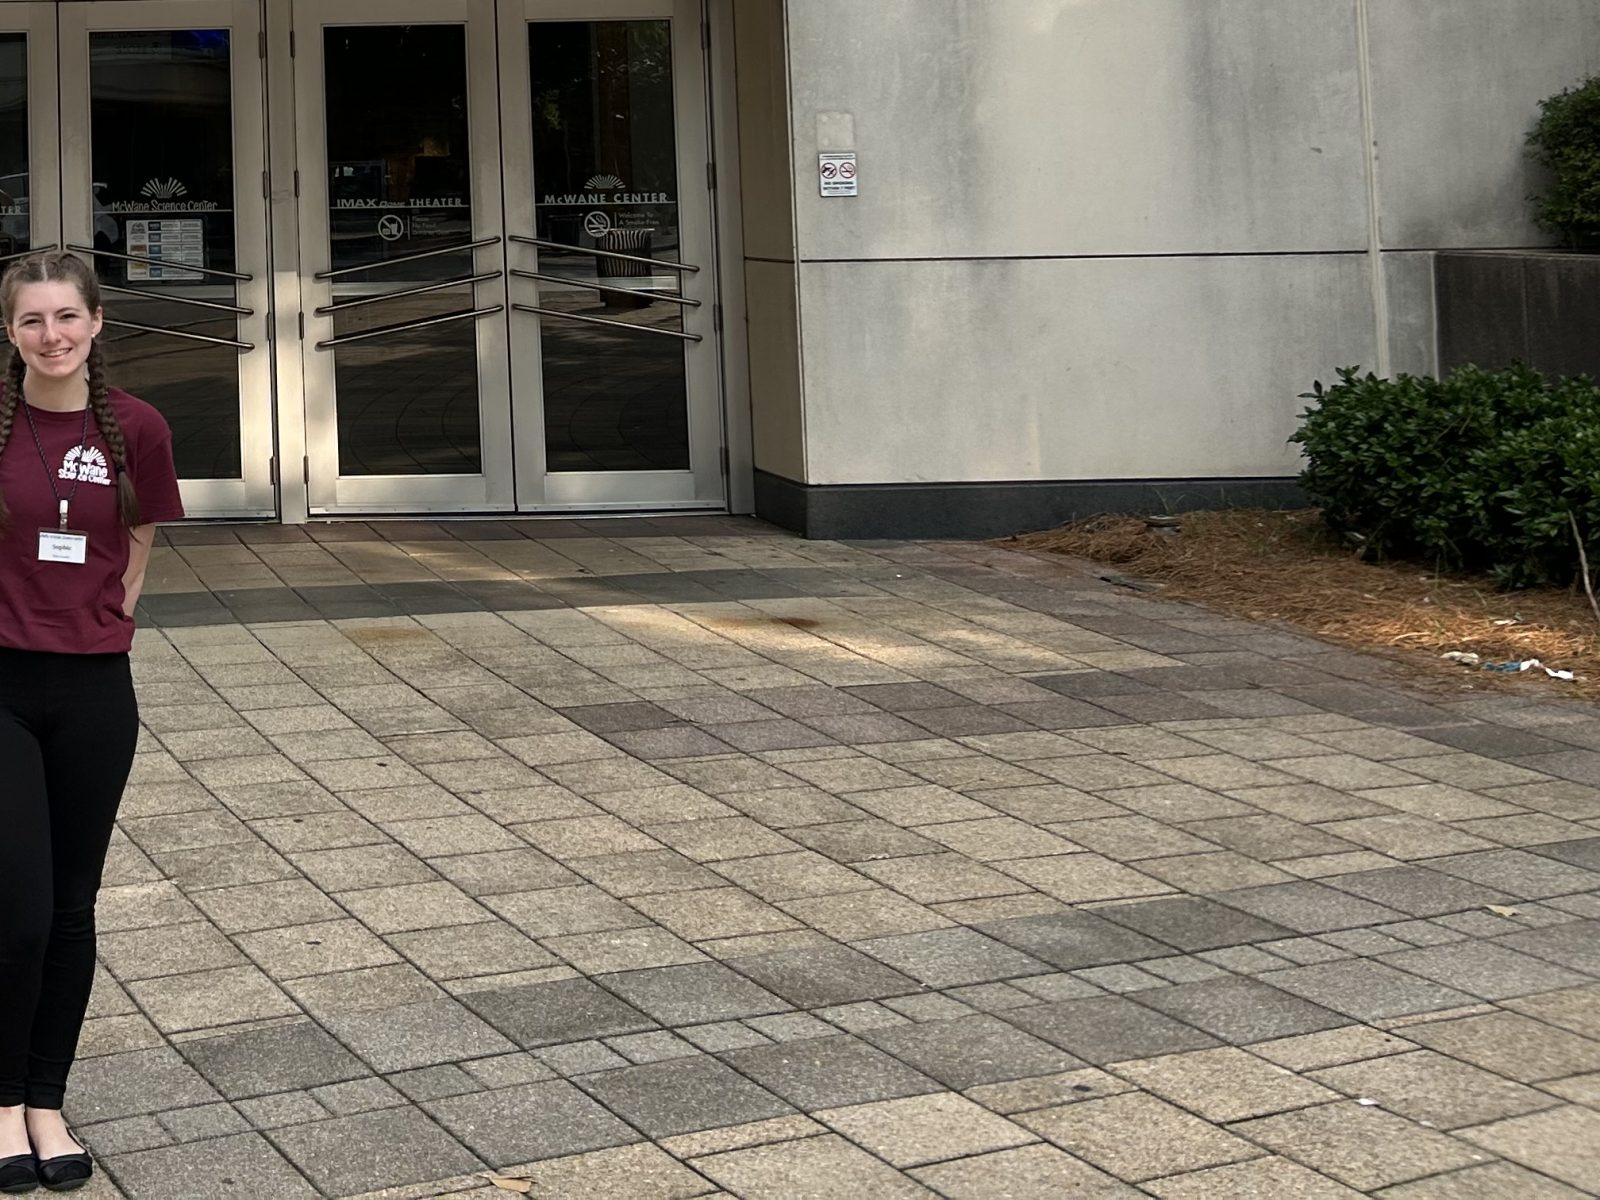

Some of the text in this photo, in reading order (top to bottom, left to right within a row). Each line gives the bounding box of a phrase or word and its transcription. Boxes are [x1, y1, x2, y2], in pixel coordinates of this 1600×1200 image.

[337, 199, 377, 207] IMAX
[409, 198, 462, 207] THEATER
[544, 193, 668, 204] McWANE CENTER
[112, 200, 218, 212] McWane Science Center
[63, 460, 108, 478] McWane
